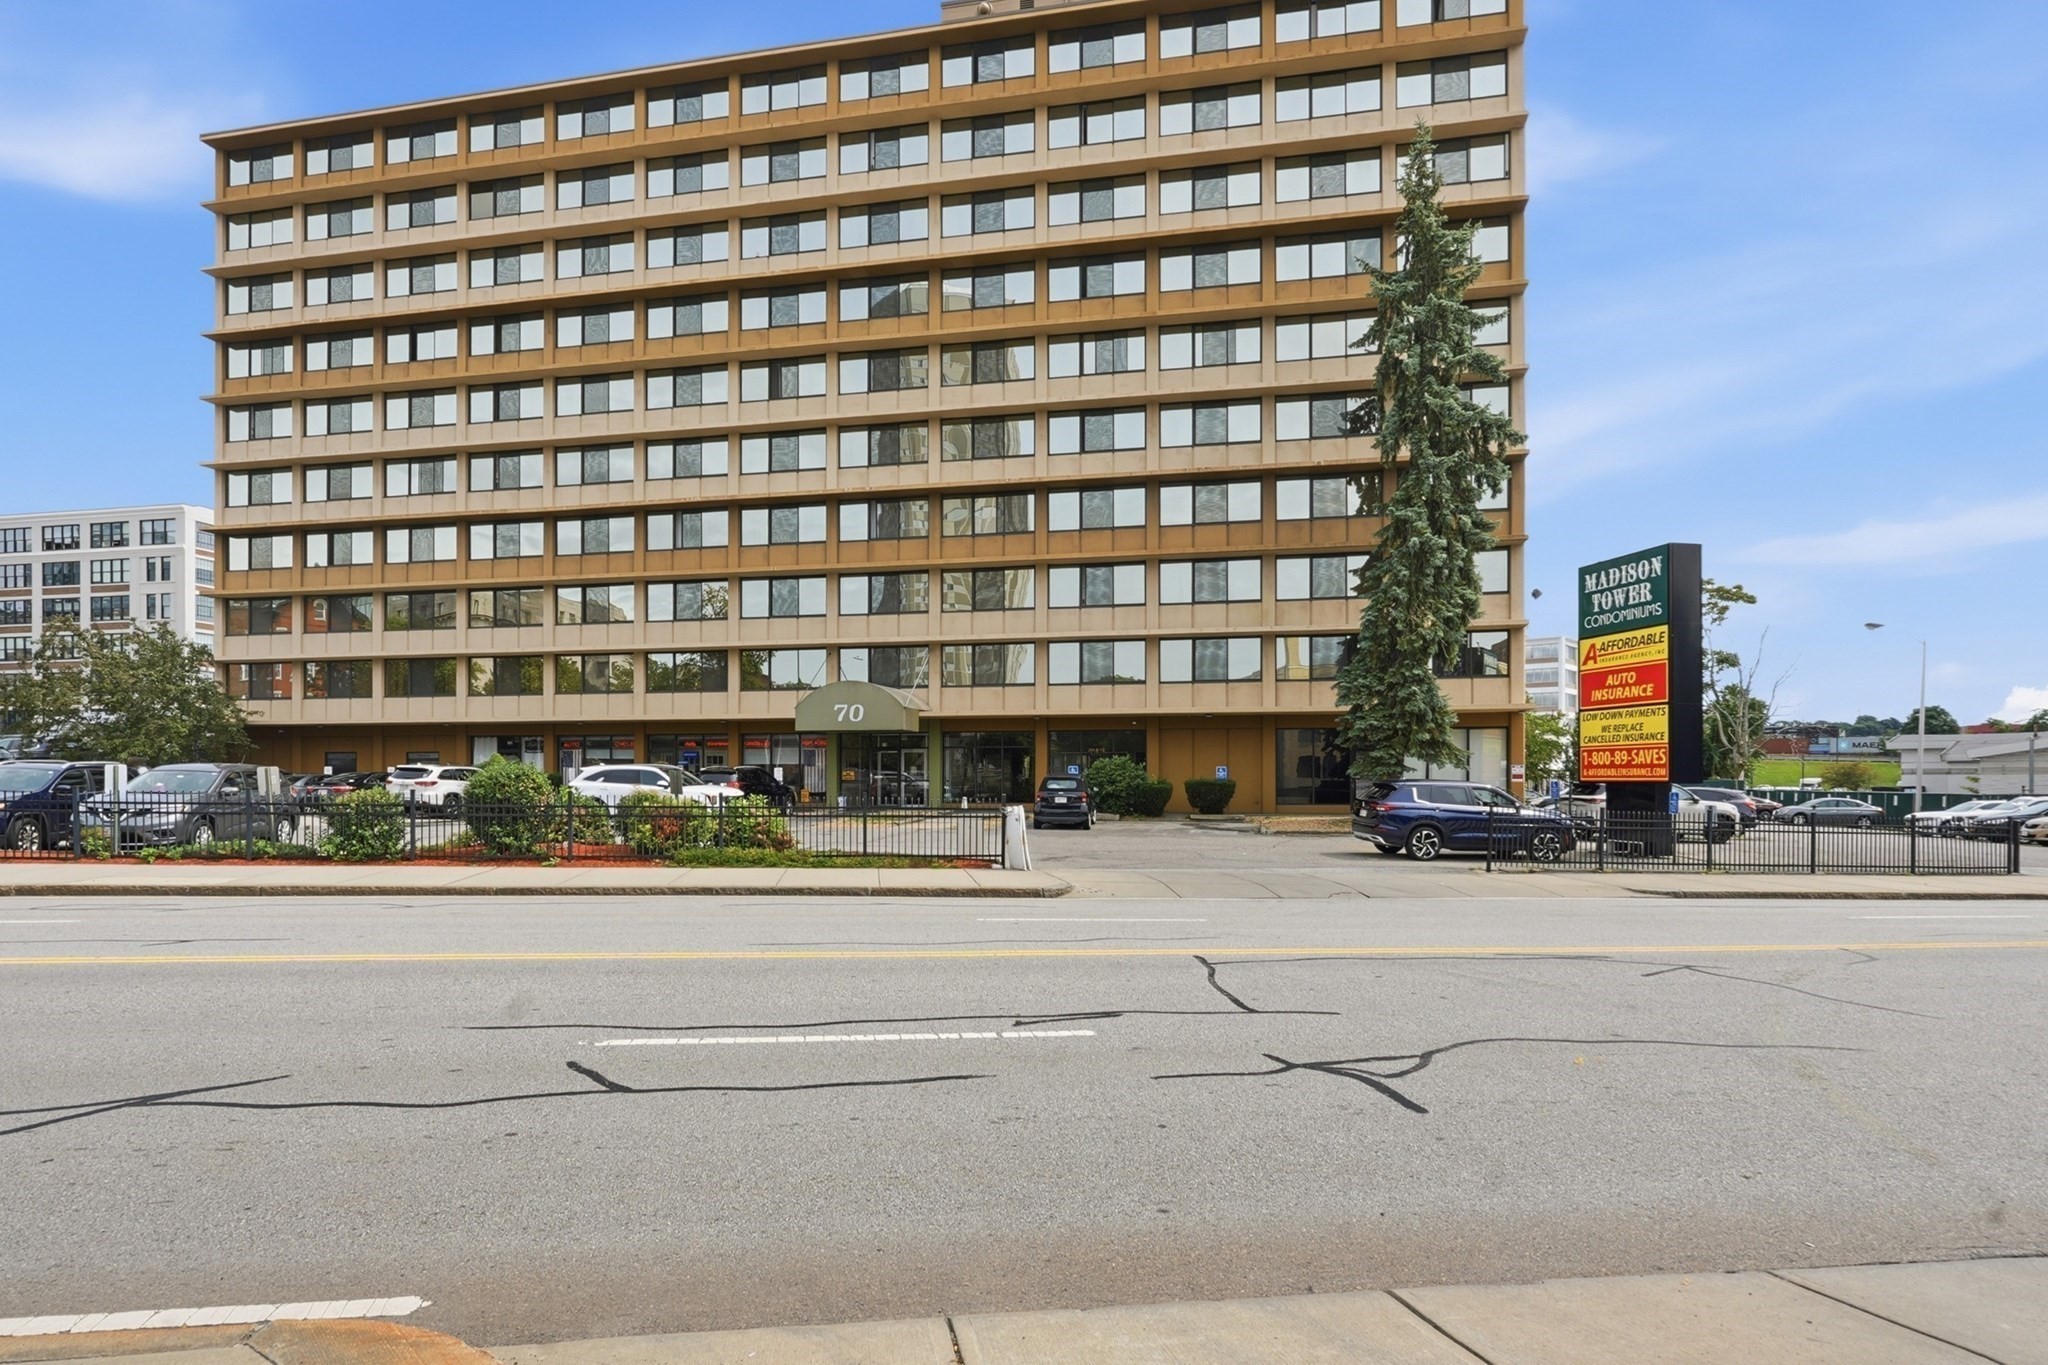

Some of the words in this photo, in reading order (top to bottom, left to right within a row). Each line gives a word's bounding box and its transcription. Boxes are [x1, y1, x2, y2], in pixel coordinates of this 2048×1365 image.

[1584, 556, 1662, 593] MADISON
[1591, 582, 1653, 613] TOWER
[1584, 603, 1663, 628] CONDOMINIUMS
[1606, 671, 1637, 687] AUTO
[1591, 684, 1654, 702] INSURANCE
[833, 704, 864, 722] 70
[1582, 711, 1599, 722] LOW
[1600, 709, 1624, 720] DOWN
[1625, 707, 1666, 718] PAYMENTS
[1601, 724, 1612, 733] WE
[1613, 722, 1644, 733] REPLACE
[1583, 734, 1621, 744] CANCELLED
[1622, 732, 1665, 741] INSURANCE
[1583, 749, 1666, 765] 1-800-89-SAVES
